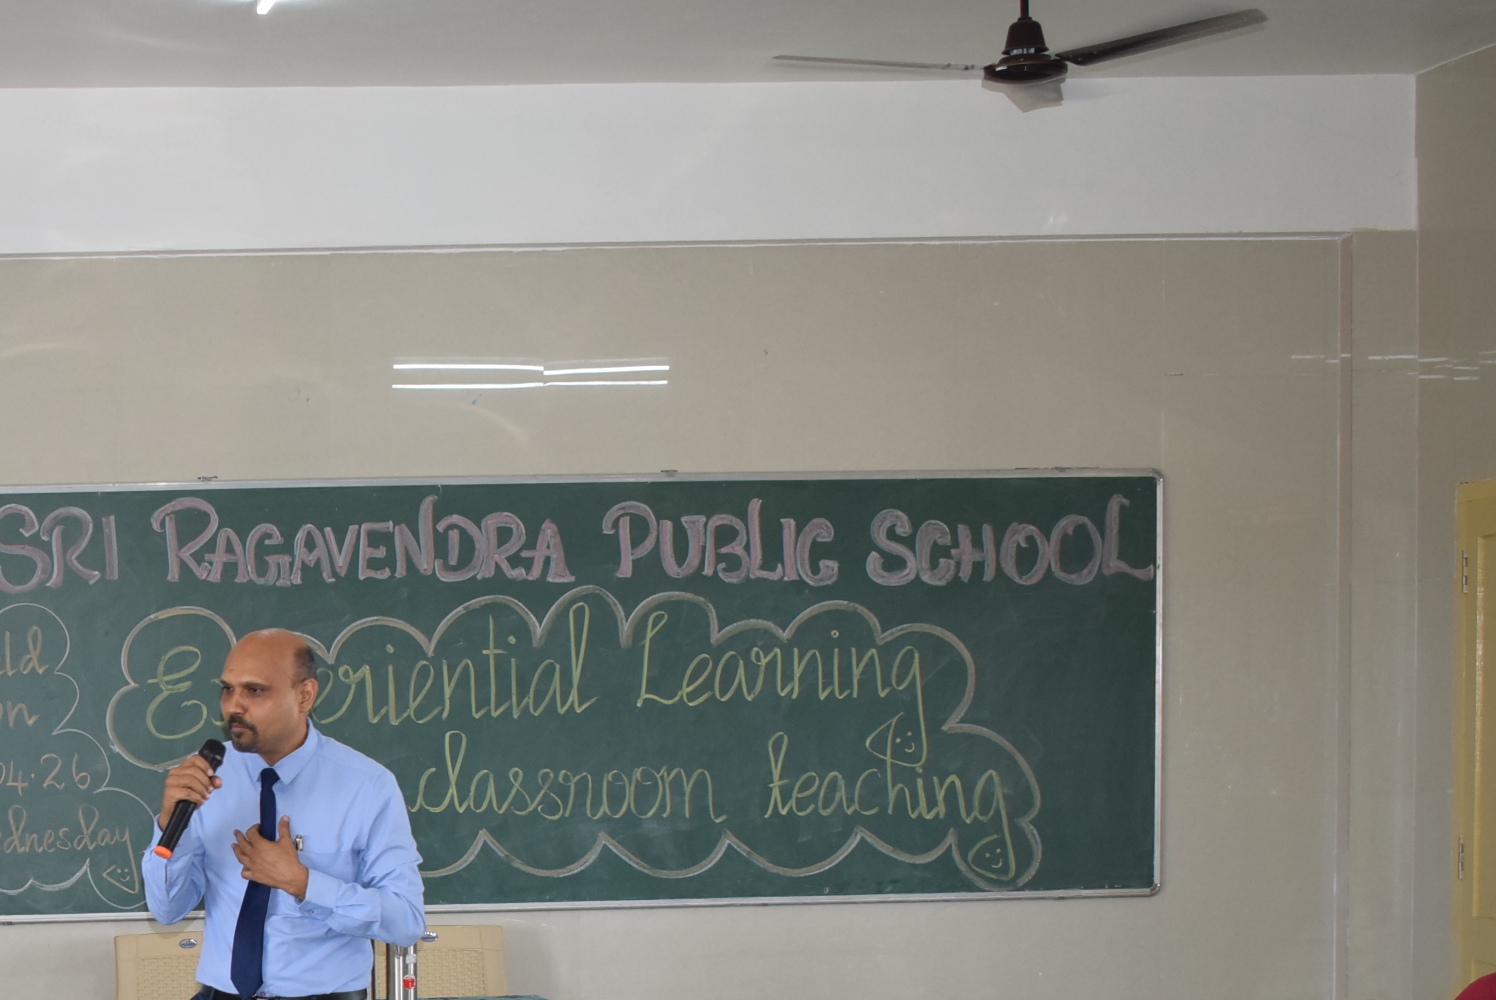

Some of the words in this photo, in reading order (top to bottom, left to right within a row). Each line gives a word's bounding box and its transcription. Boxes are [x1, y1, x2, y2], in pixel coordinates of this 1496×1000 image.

[151, 495, 576, 587] RAGAVENDRA
[602, 498, 840, 586] PUBLIC
[866, 494, 1154, 586] SCHOOL
[146, 602, 600, 739] Eeriential
[636, 610, 928, 767] Learning
[407, 731, 727, 824] classroom
[764, 732, 1015, 880] teaching
